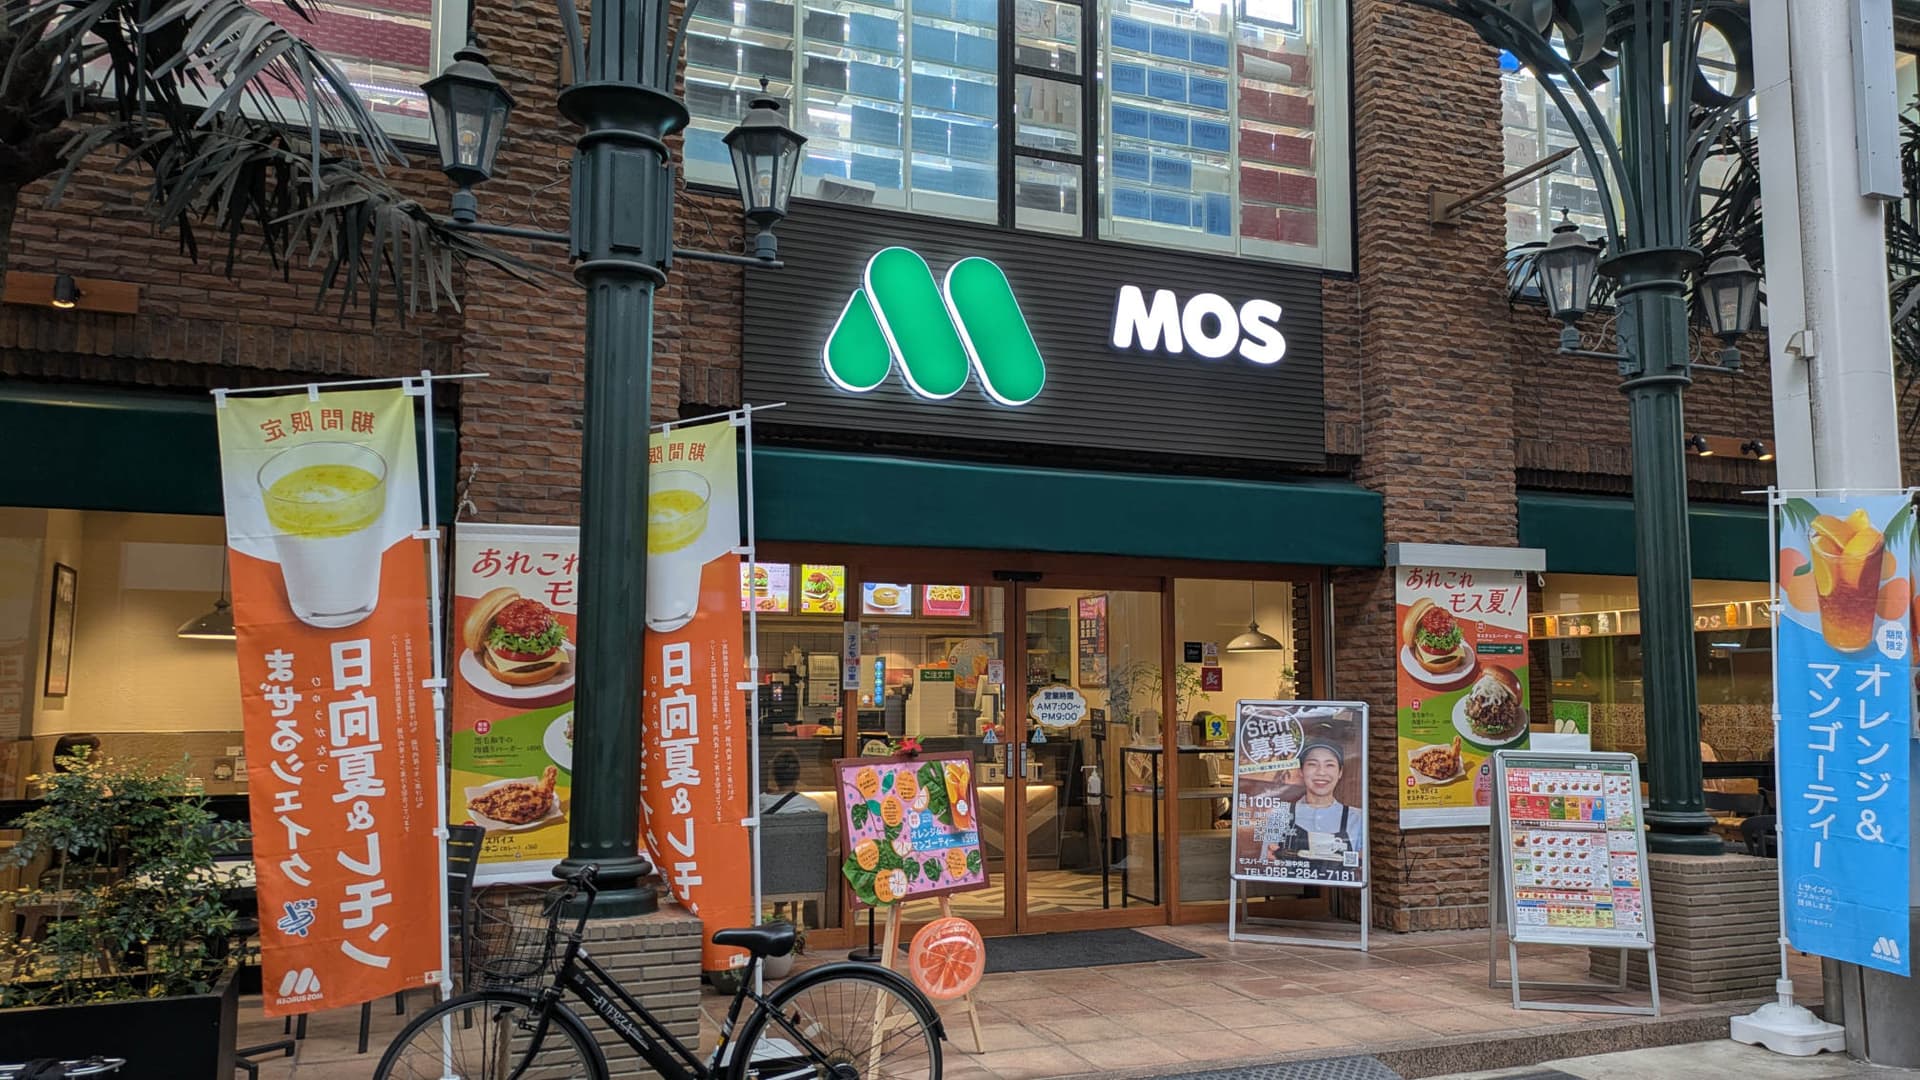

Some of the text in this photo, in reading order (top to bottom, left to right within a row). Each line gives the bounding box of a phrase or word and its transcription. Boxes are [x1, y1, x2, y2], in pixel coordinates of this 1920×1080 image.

[1113, 285, 1287, 365] MOS
[1406, 567, 1474, 590] あれこれ
[1448, 585, 1522, 616] モス夏!
[1695, 615, 1721, 630] OS
[1041, 712, 1078, 720] PM9:00
[1248, 733, 1297, 760] 募集
[1855, 662, 1892, 843] オレンジ&
[1803, 662, 1843, 869] マンゴーティー
